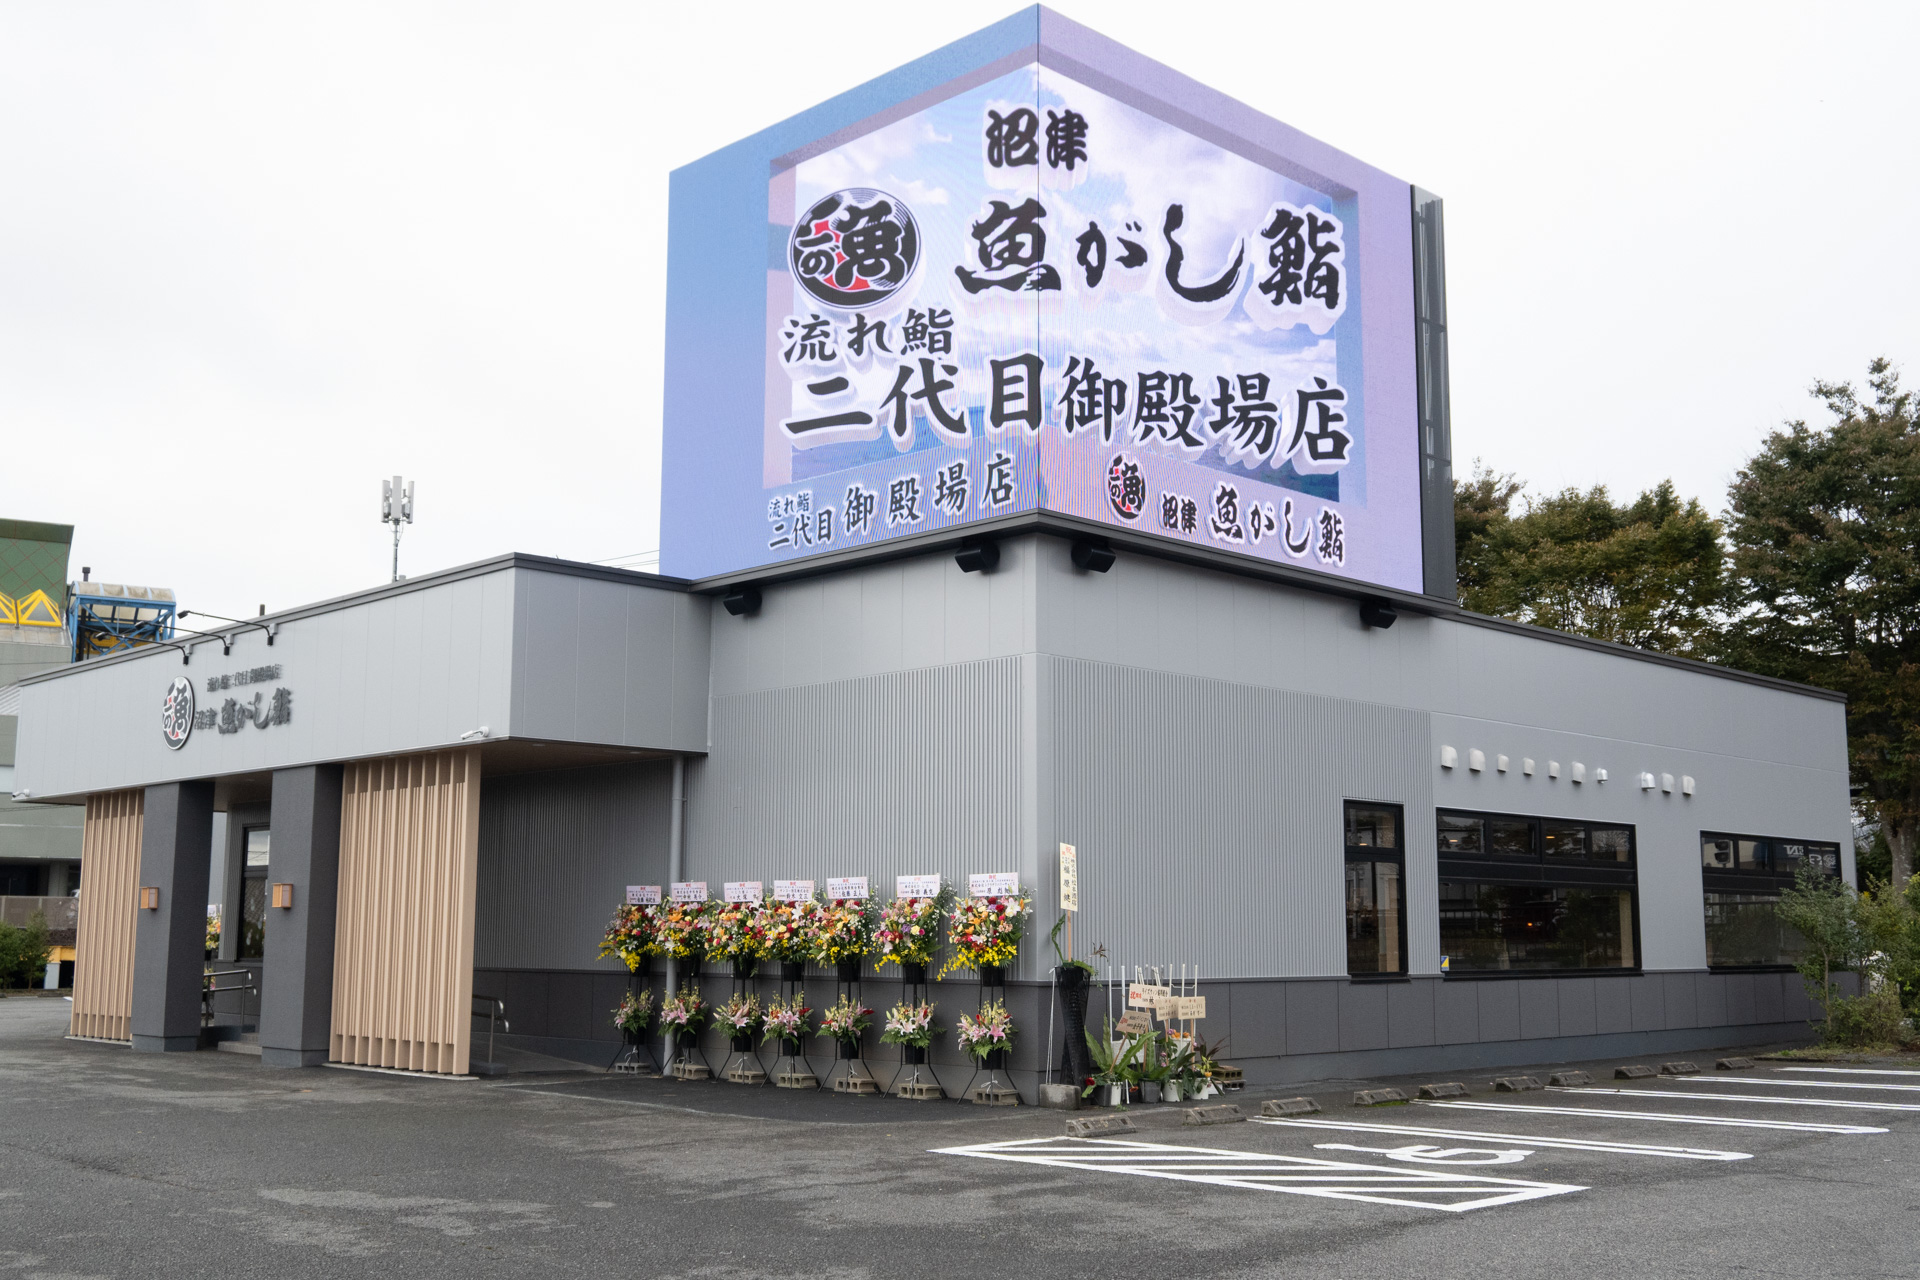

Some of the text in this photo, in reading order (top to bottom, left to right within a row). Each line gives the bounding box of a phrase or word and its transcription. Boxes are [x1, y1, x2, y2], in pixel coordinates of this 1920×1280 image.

[985, 107, 1089, 171] 沼津
[955, 199, 1340, 309] 魚がし鮨
[784, 308, 955, 364] 流れ鮨
[784, 353, 1351, 464] 二代目御殿場店
